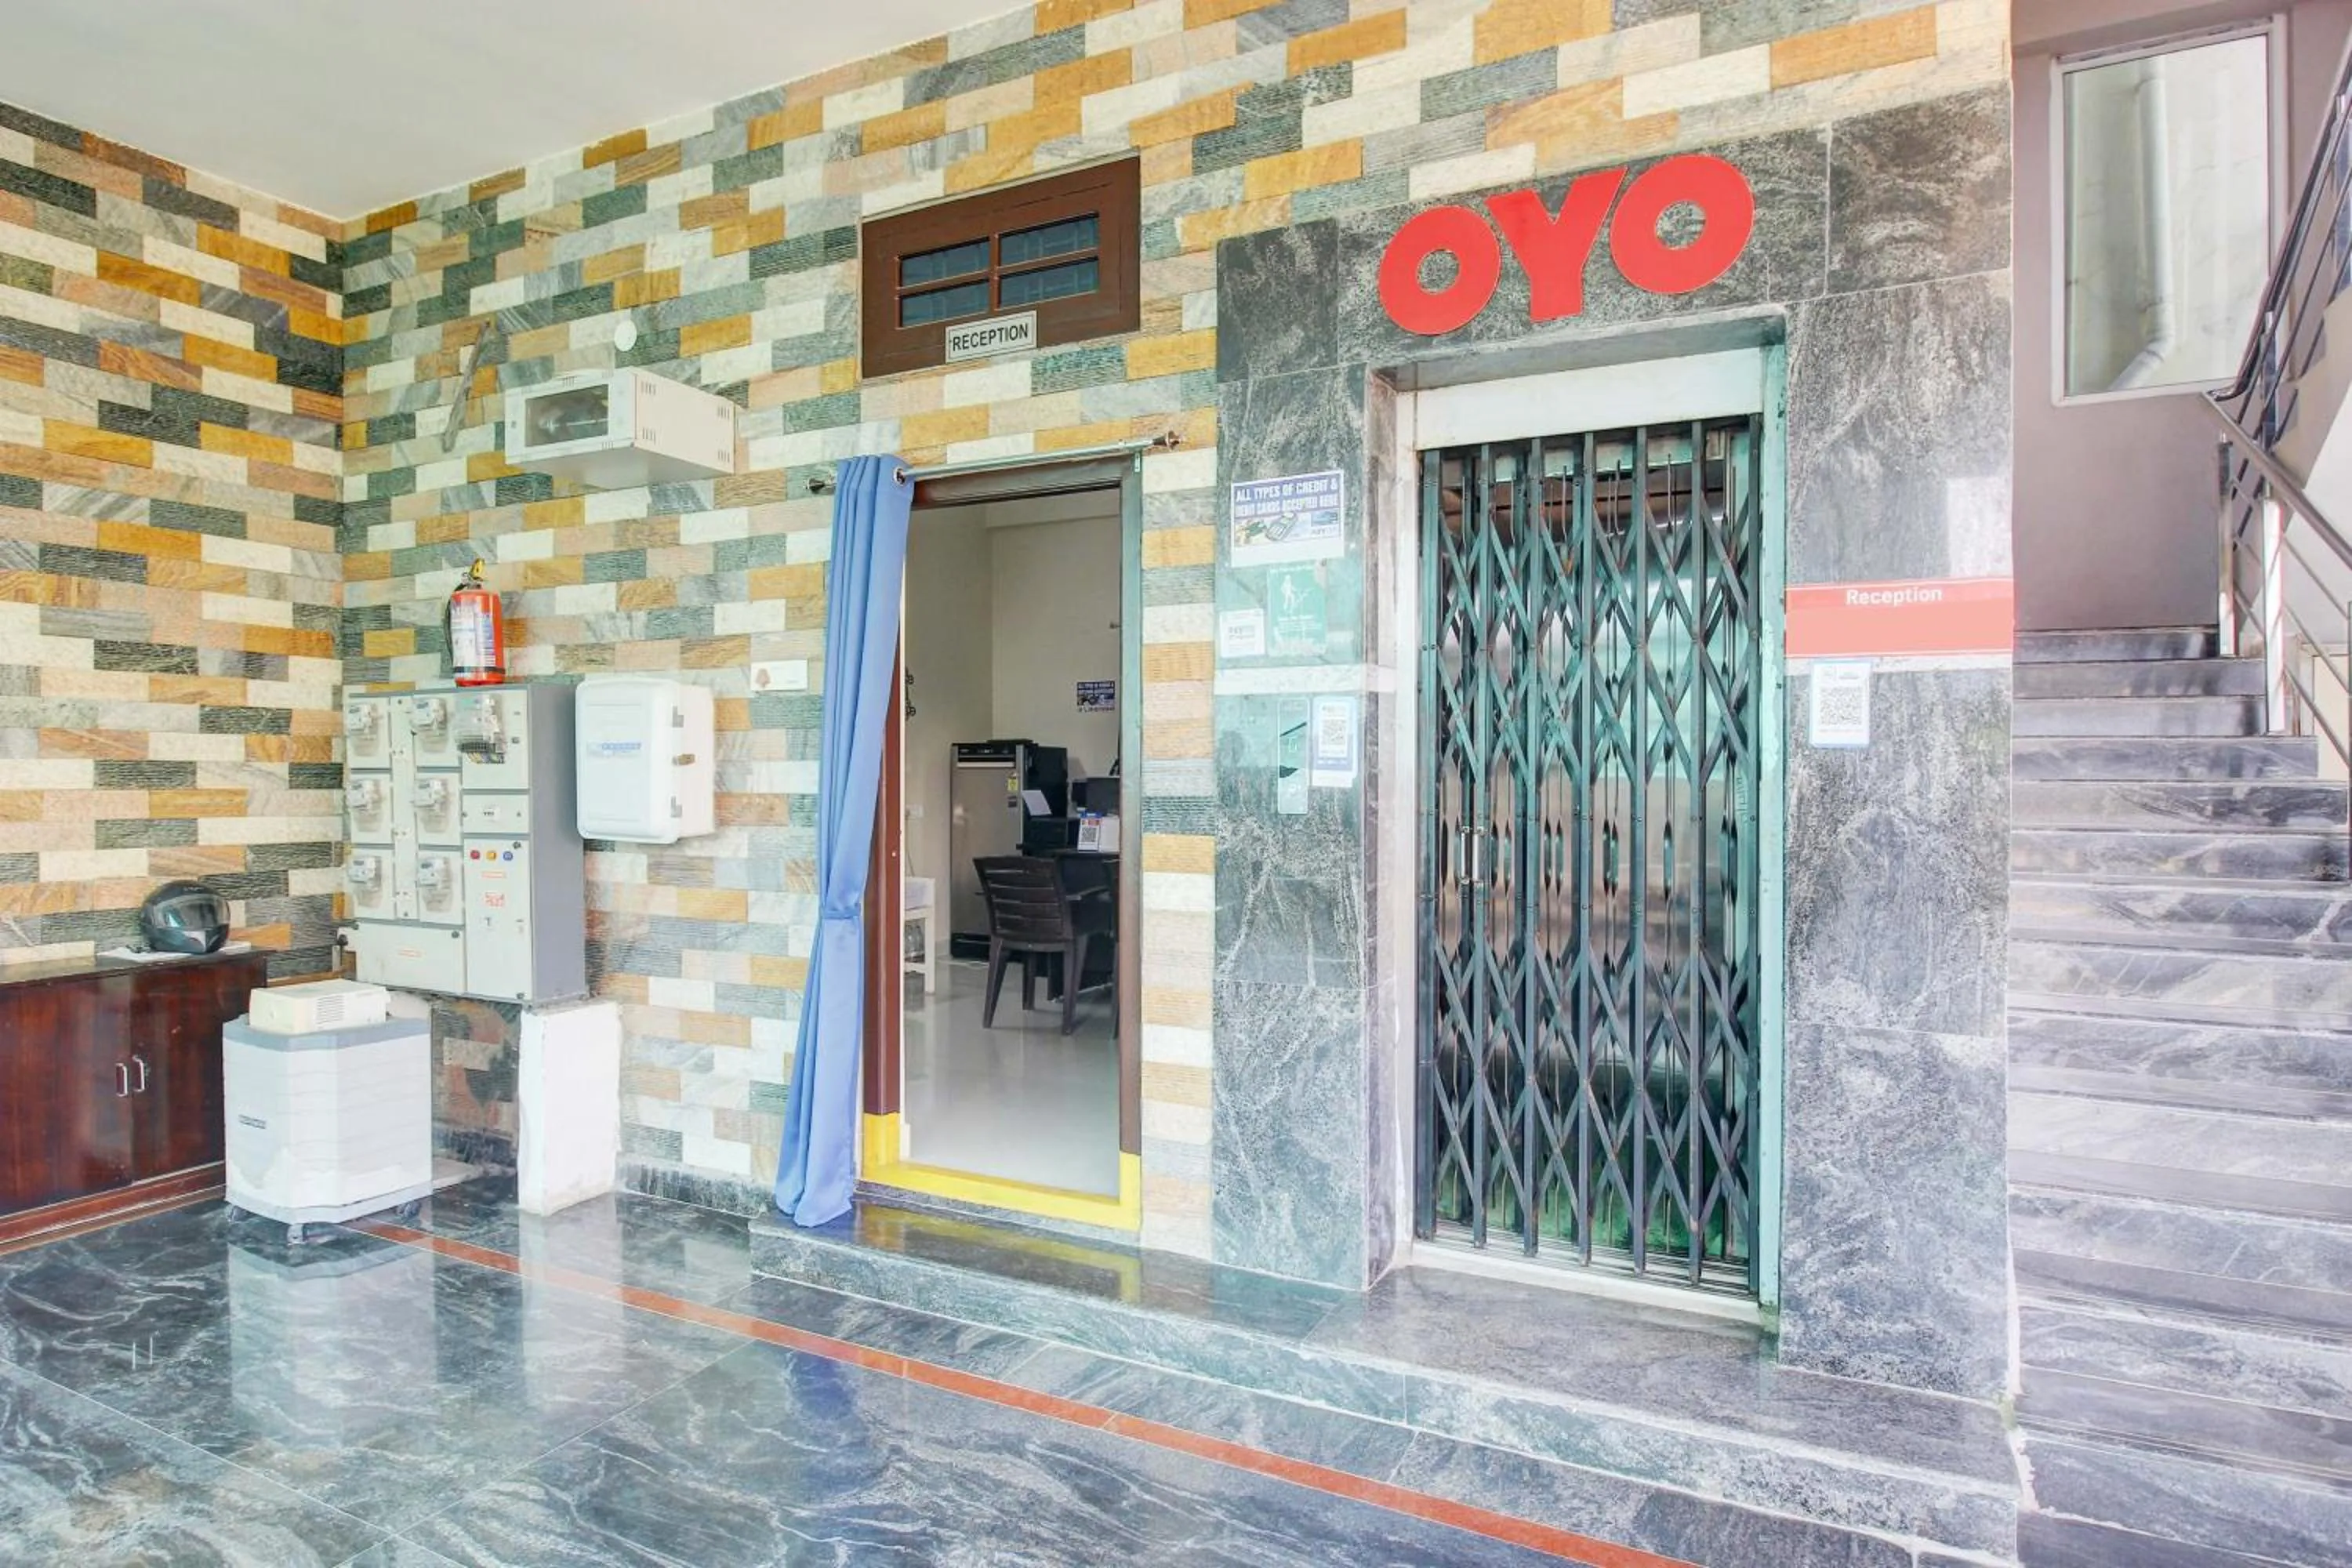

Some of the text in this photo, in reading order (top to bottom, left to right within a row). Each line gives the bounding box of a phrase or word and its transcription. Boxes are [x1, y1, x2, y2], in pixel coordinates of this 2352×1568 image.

[1378, 154, 1755, 336] OYO
[952, 322, 1029, 351] RECEPTION
[1236, 477, 1338, 502] ALL TYPES OF CREDIT &
[1846, 587, 1942, 606] Reception
